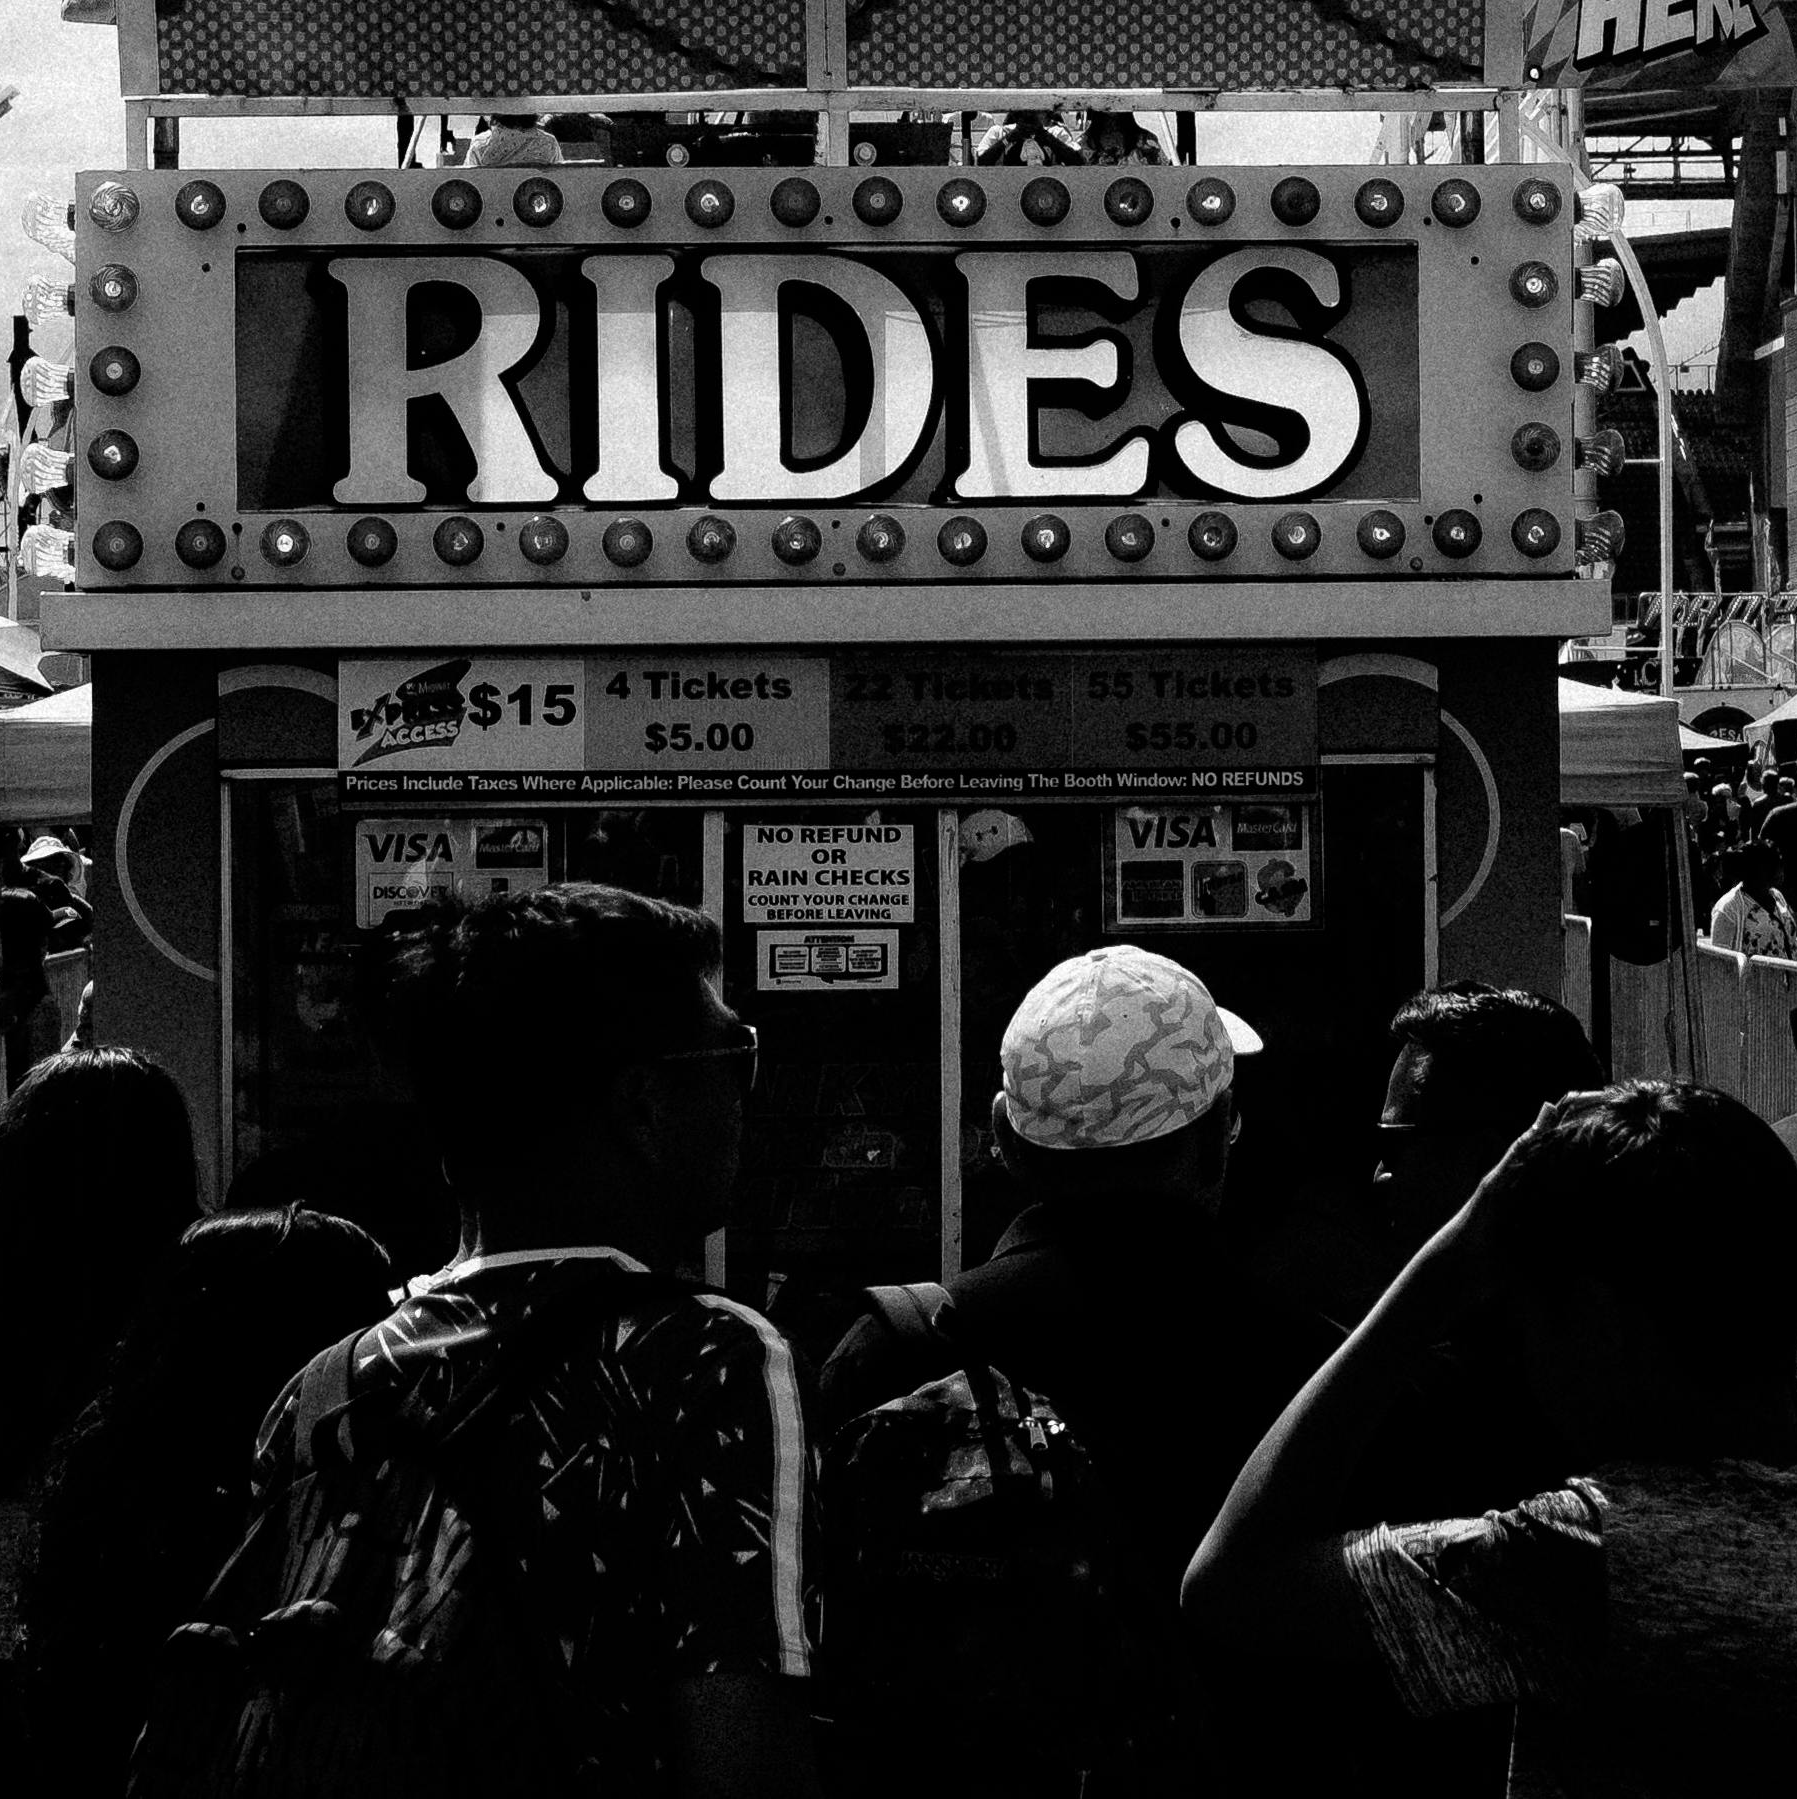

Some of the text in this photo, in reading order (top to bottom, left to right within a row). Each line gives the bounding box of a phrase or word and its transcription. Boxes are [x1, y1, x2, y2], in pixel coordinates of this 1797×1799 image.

[326, 245, 1373, 505] RIDES
[606, 671, 792, 700] 4 Tickets
[845, 671, 1054, 701] 22 Tickets
[1088, 671, 1295, 699] 55 Tickets
[468, 682, 576, 729] $15
[380, 721, 459, 749] ACCESS
[644, 722, 753, 754] $5.00
[883, 722, 1016, 754] $22.00
[1126, 722, 1257, 752] $55.00
[345, 771, 1305, 794] Prices Include Taxes Where Applicable: Please Count Your Change Before Leaving The Booth Window: NO REFUNDS
[757, 827, 901, 843] NO REFUND
[1128, 816, 1216, 849] VISA
[363, 834, 453, 862] VISA
[811, 849, 846, 864] OR
[748, 869, 910, 886] RAIN CHECKS
[748, 894, 909, 906] COUNT YOUR CHANGE
[767, 908, 891, 920] BEFORE LEAVING
